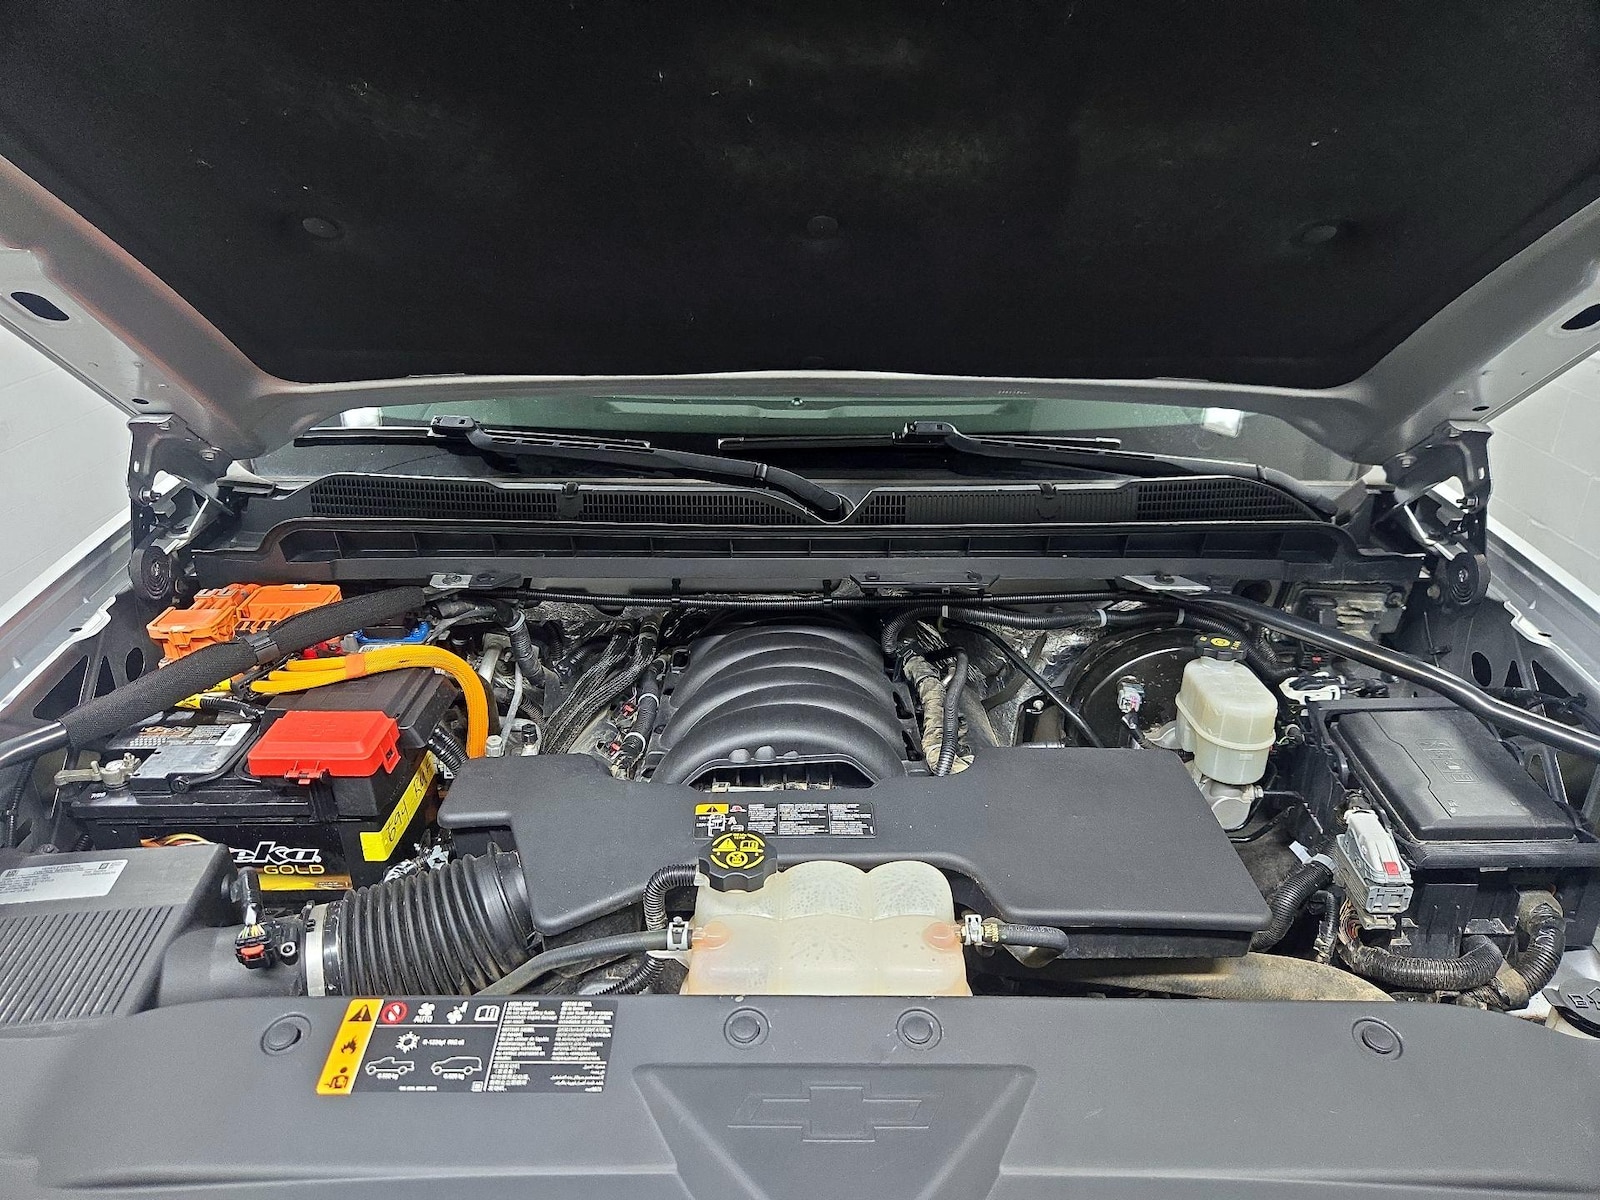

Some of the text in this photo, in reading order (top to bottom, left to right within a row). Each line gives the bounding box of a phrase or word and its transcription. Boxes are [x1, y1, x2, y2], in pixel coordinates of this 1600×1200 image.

[229, 841, 322, 865] eka
[263, 864, 325, 875] GOLD
[413, 1015, 433, 1023] AUTO
